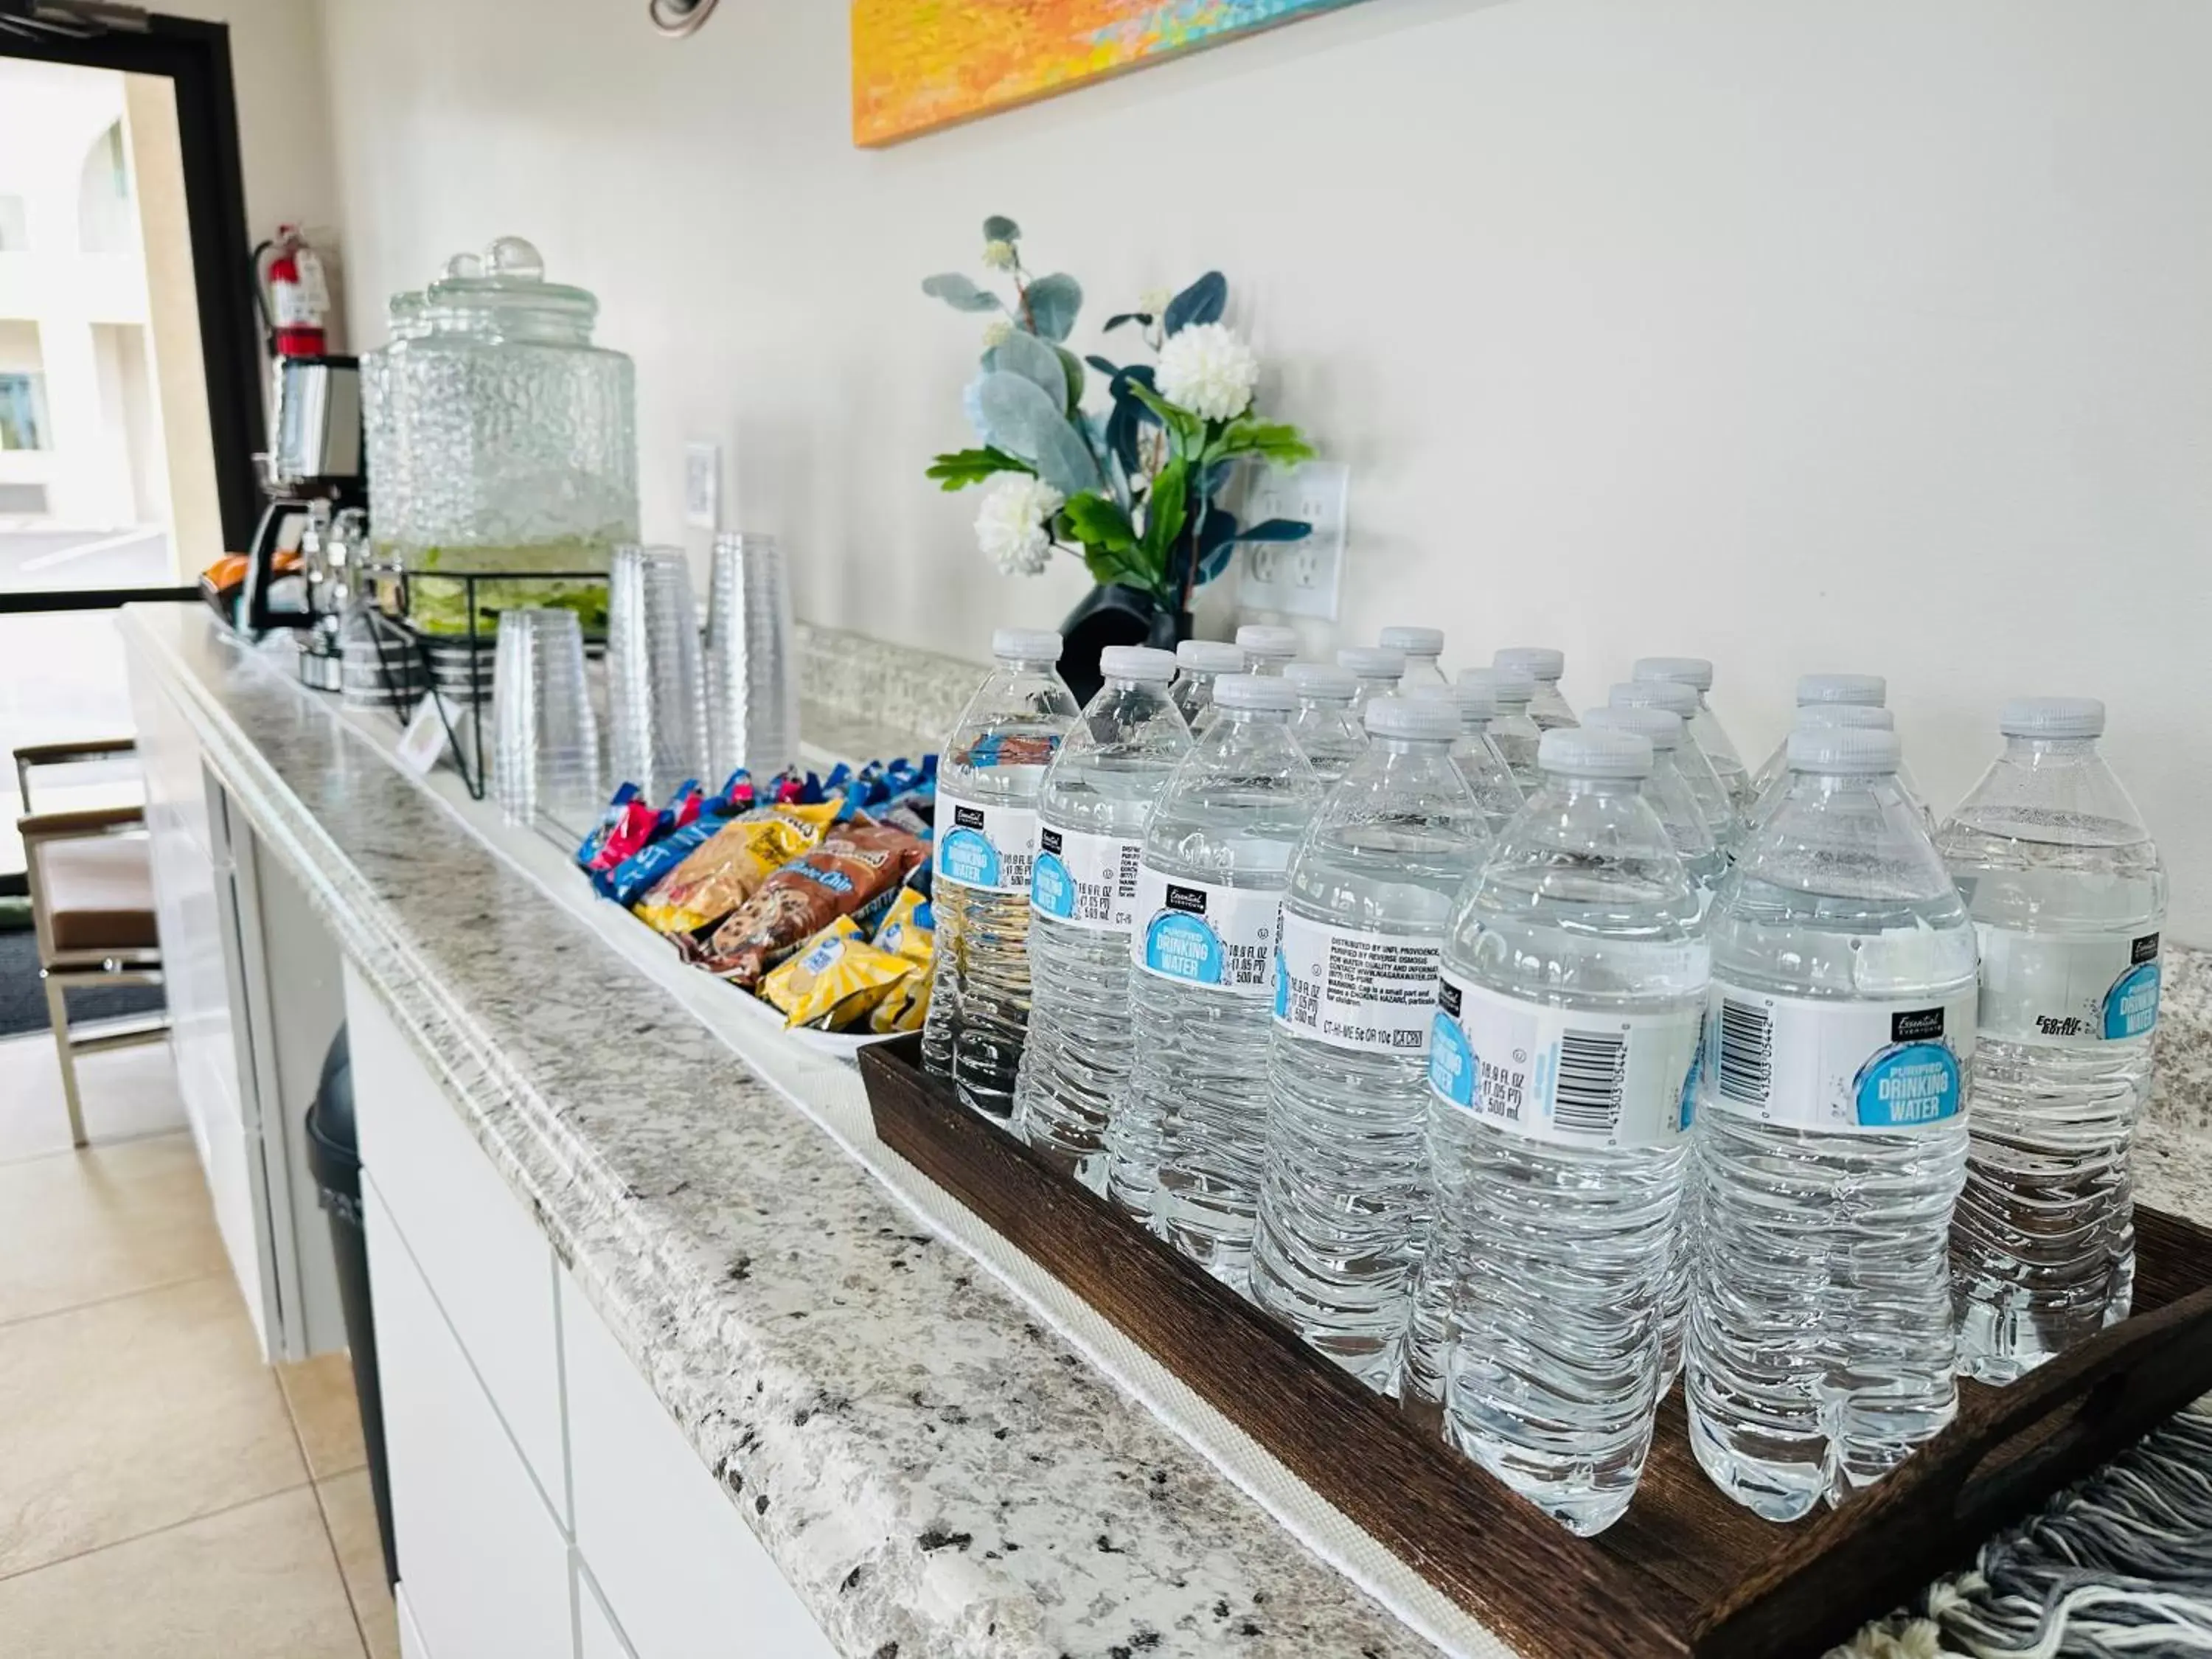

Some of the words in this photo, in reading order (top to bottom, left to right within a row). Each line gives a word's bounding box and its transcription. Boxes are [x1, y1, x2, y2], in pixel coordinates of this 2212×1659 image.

[953, 861, 980, 882] WATER
[1011, 875, 1023, 886] 500
[1103, 886, 1112, 897] OZ
[1157, 932, 1208, 961] DRINKING
[1257, 946, 1267, 959] OZ
[1332, 937, 1370, 950] DISTRIBUTED
[1371, 944, 1381, 952] BY
[1400, 947, 1440, 957] PROVIDENCE,
[1329, 955, 1341, 963] FOR
[1343, 958, 1363, 967] WATER
[1365, 961, 1392, 970] QUALITY
[1393, 964, 1408, 973] AND
[1331, 946, 1357, 957] PURIFIED
[1358, 951, 1368, 959] BY
[1368, 952, 1397, 962] REVERSE
[1399, 956, 1428, 965] OSMOSIS
[1161, 953, 1199, 977] WATER
[1253, 959, 1265, 972] PT)
[1329, 961, 1356, 973] CONTACT
[1237, 971, 1251, 984] 500
[1311, 984, 1321, 998] OZ
[1350, 990, 1378, 1001] CHOKING
[1358, 984, 1371, 993] Cap
[1403, 990, 1417, 998] part
[1295, 1007, 1307, 1023] 500
[1899, 1013, 1939, 1030] Essential
[2036, 1015, 2081, 1029] Eco-Air
[1365, 1028, 1377, 1043] OR
[1761, 1020, 1773, 1057] 05442
[1613, 1045, 1628, 1083] 05442
[1890, 1062, 1943, 1078] PURIFIED
[1500, 1068, 1509, 1085] FL
[1512, 1072, 1525, 1090] OZ
[1760, 1062, 1772, 1098] 41303
[1878, 1071, 1949, 1100] DRINKING
[1507, 1088, 1523, 1107] PT)
[1488, 1099, 1505, 1116] 500
[1608, 1088, 1622, 1125] 41303
[1890, 1096, 1939, 1121] WATER
